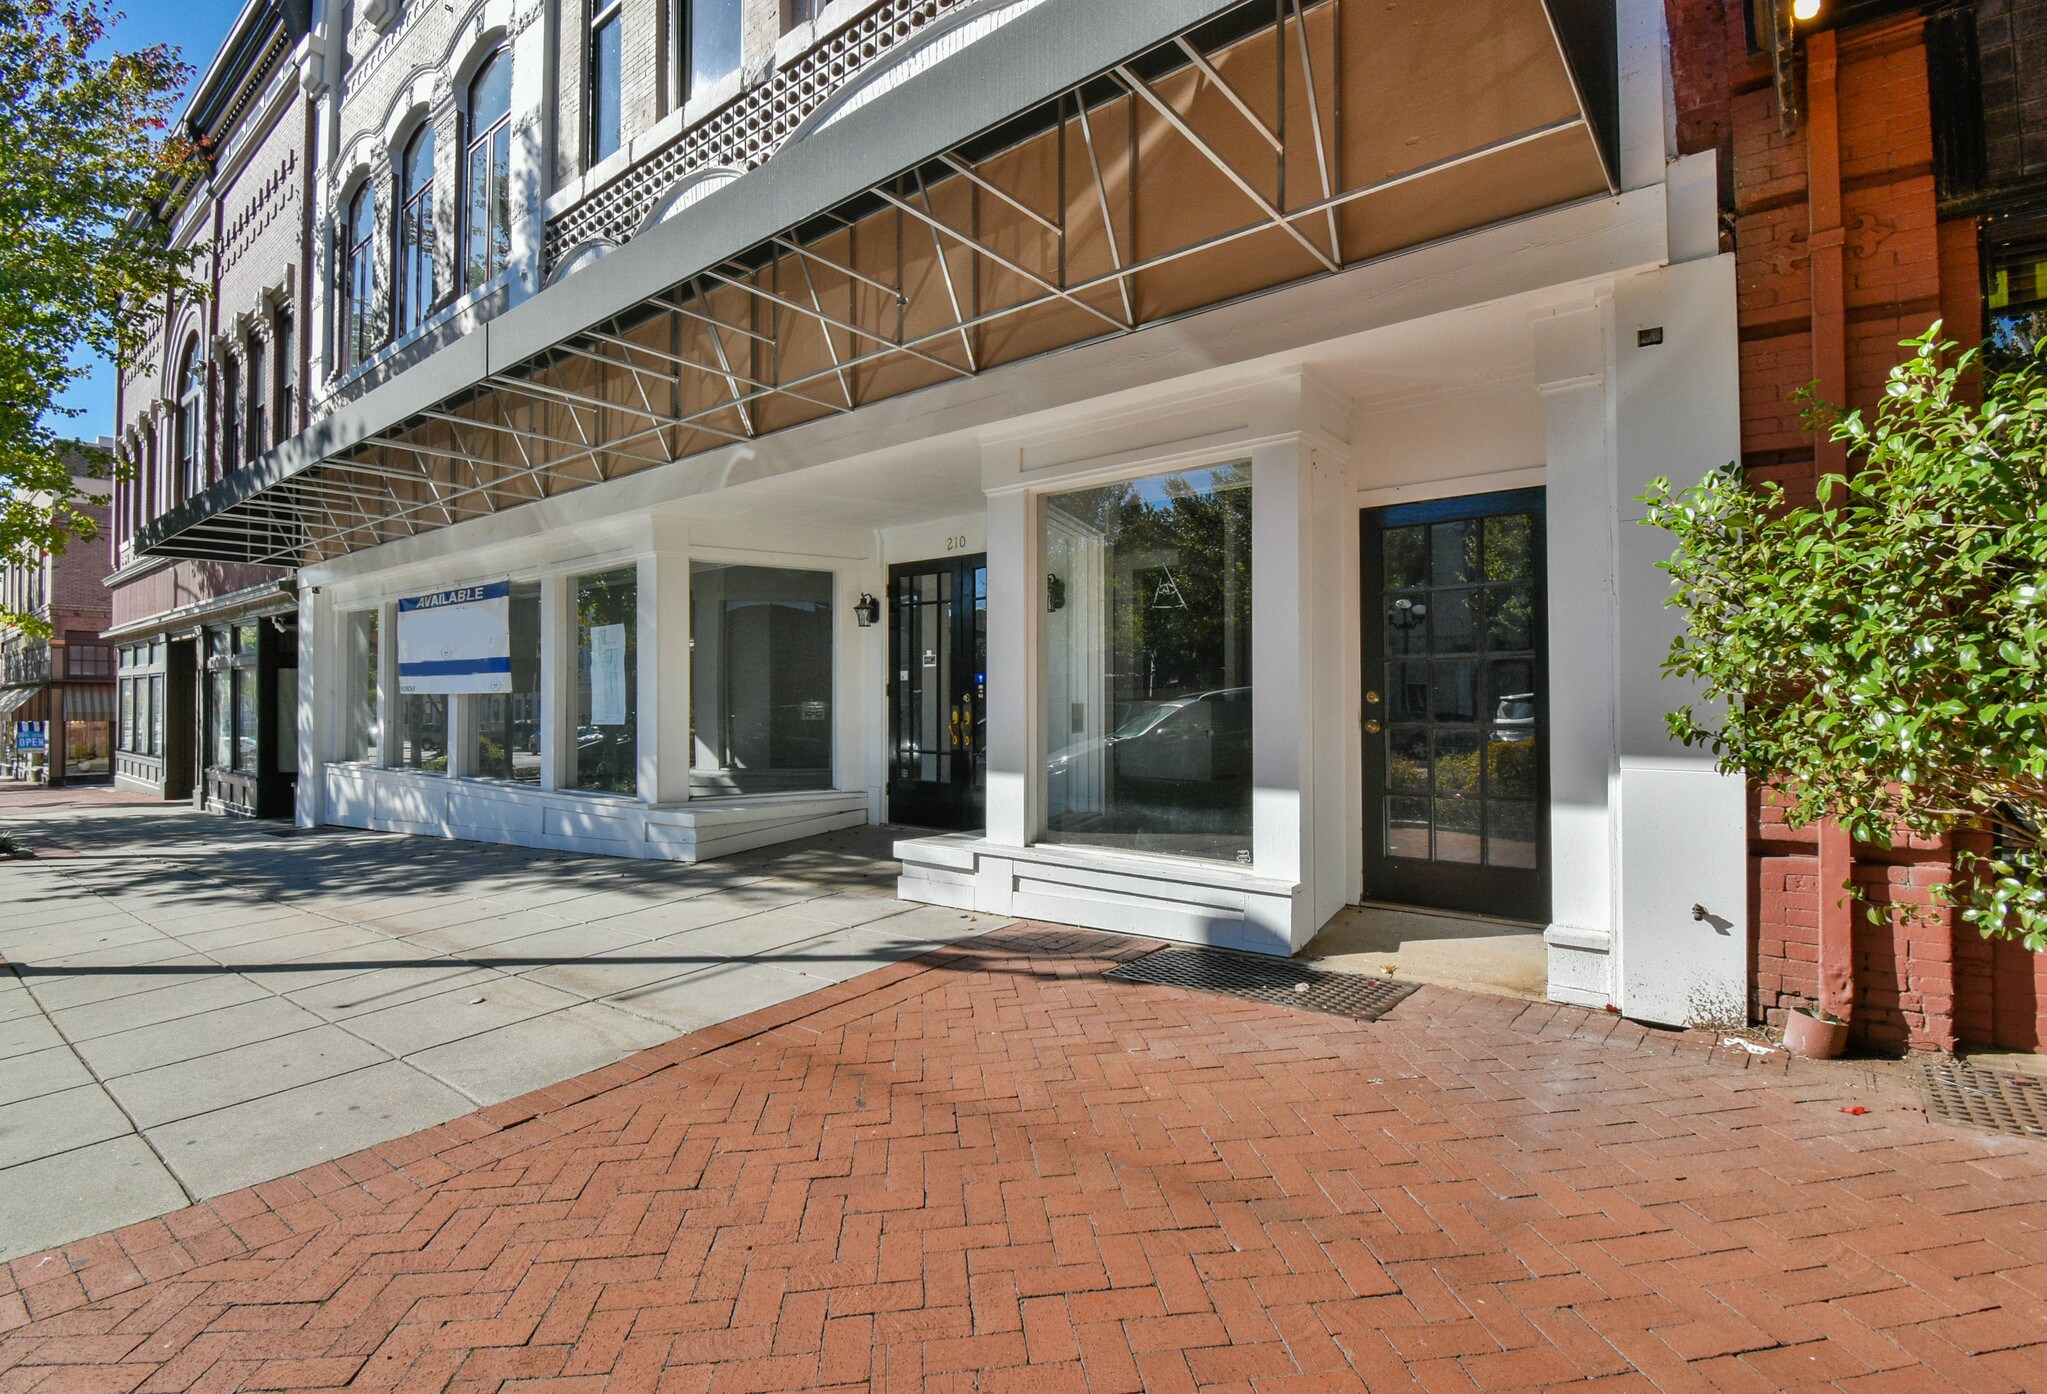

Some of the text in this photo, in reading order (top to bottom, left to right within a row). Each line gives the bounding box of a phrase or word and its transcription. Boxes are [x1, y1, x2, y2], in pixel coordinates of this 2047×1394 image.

[947, 536, 965, 550] 210
[416, 587, 484, 608] AVAILABLE
[19, 737, 44, 747] OPEN
